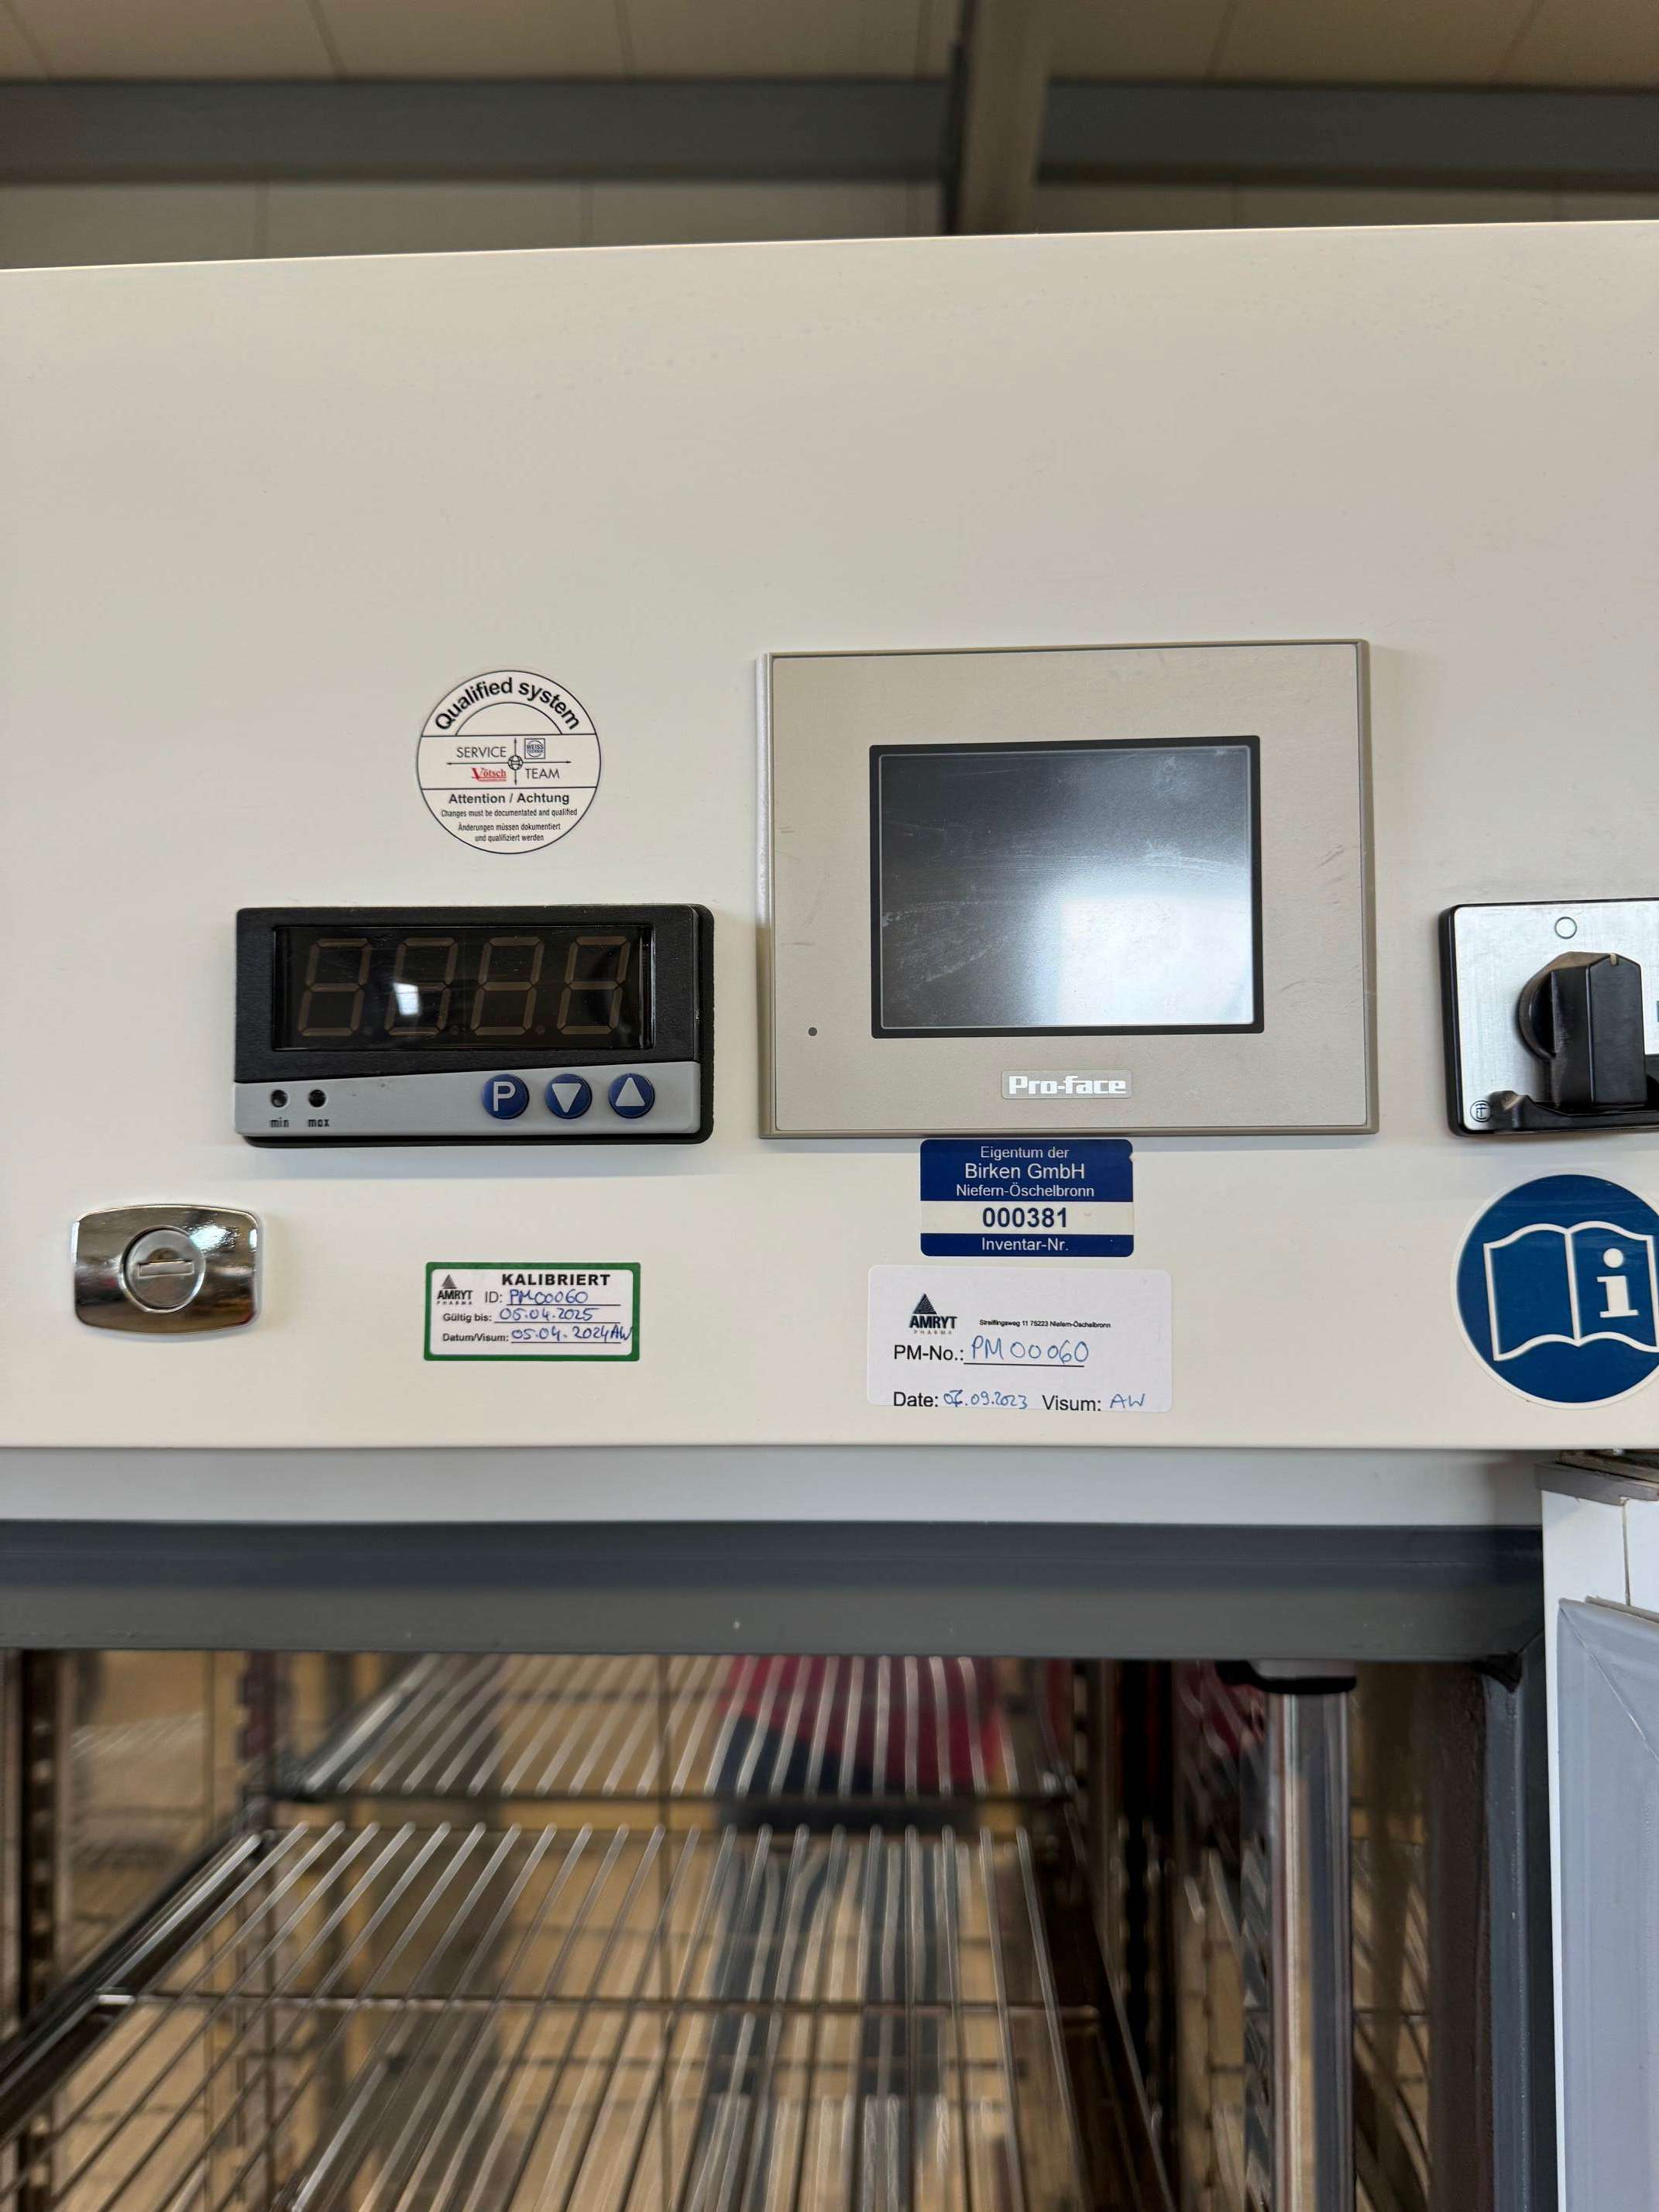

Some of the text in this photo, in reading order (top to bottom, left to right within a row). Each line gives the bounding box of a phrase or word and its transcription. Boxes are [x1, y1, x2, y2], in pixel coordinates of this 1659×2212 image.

[435, 677, 580, 730] Qualified system
[456, 747, 507, 758] SERVICE
[525, 768, 560, 779] TEAM
[448, 794, 506, 804] Attention
[517, 793, 569, 805] Achtung
[441, 809, 466, 818] Changes
[551, 808, 578, 817] qualified
[458, 823, 561, 833] Änderungen müssen dokumentiert
[488, 834, 520, 843] qualifiziert
[1008, 1075, 1126, 1094] Pro-face
[493, 1081, 516, 1111] P
[270, 1117, 289, 1128] min
[307, 1118, 330, 1128] max
[981, 1146, 1070, 1160] Eigentum der
[965, 1163, 1085, 1179] Birken GmbH
[956, 1182, 1094, 1197] Niefern-Öschelbronn
[982, 1207, 1067, 1228] 000381
[981, 1238, 1069, 1251] Inventar-Nr.
[501, 1273, 610, 1286] KALIBRIERT
[437, 1290, 473, 1300] AMRYT
[485, 1289, 589, 1305] ID: PM00060
[442, 1307, 599, 1324] Gültig bis: 05.04.2025
[909, 1316, 957, 1329] AMRYT
[442, 1333, 509, 1342] Datum/Visum:
[894, 1345, 963, 1362] PM-No.:
[894, 1391, 939, 1407] Date:
[1042, 1395, 1101, 1412] Visum:
[1109, 1393, 1146, 1409] AW
